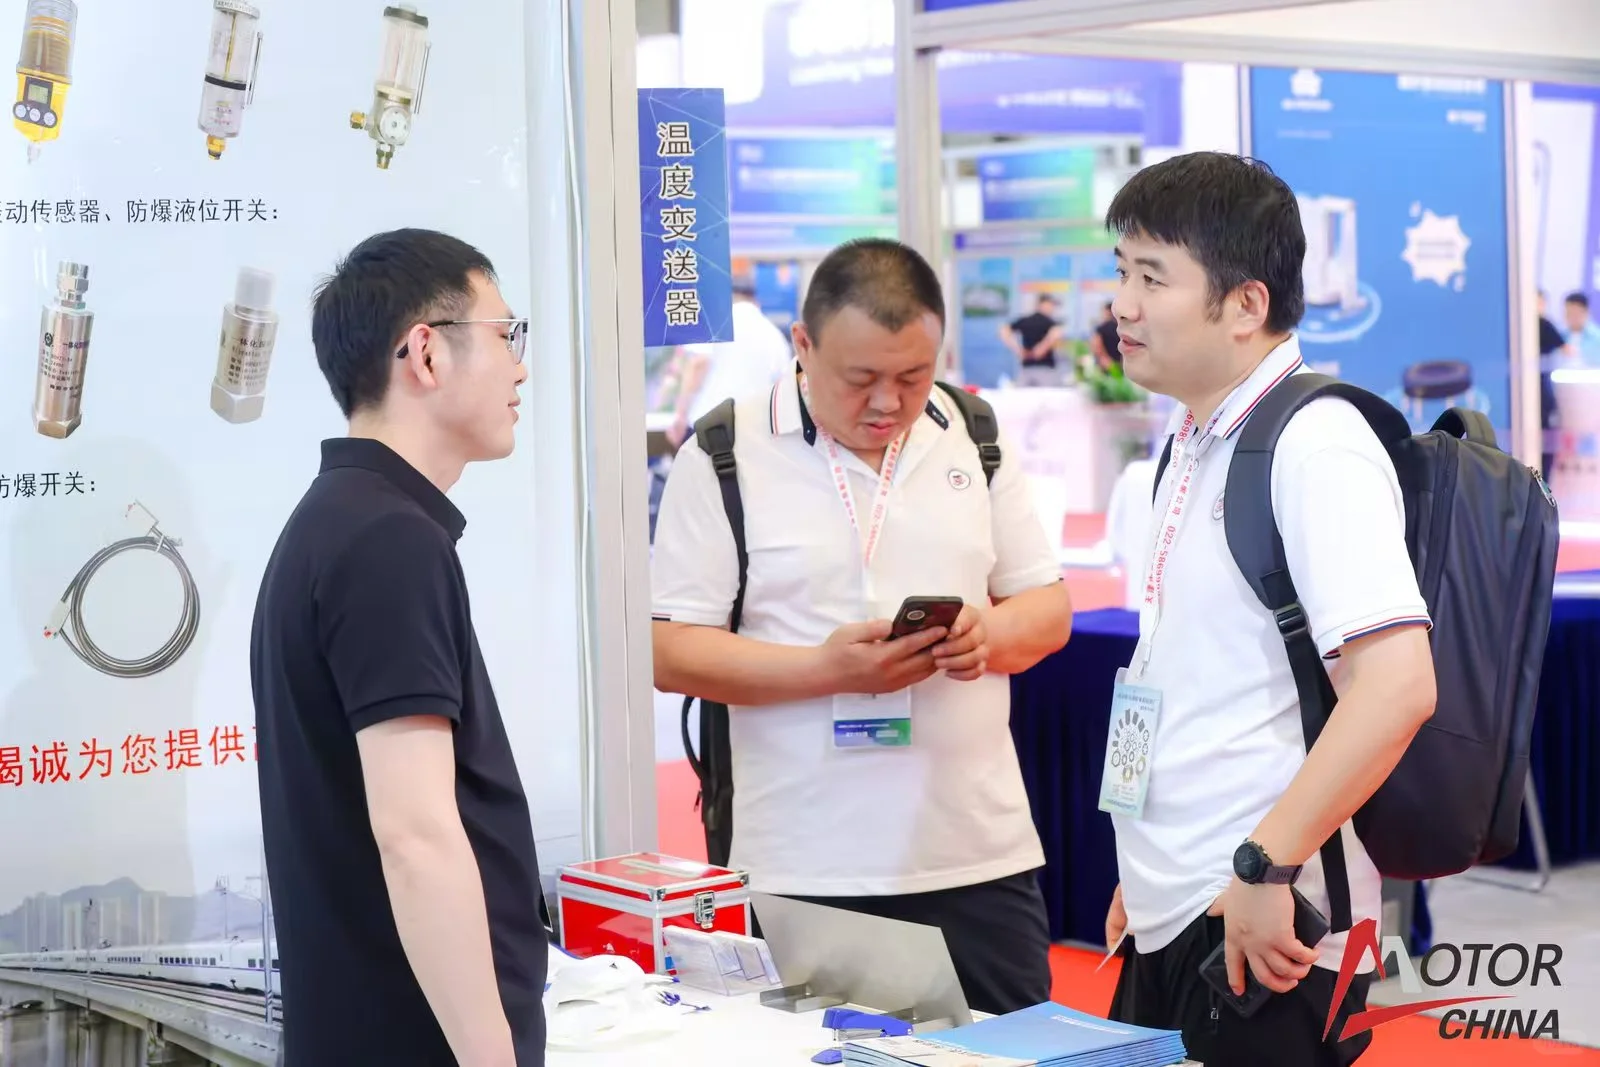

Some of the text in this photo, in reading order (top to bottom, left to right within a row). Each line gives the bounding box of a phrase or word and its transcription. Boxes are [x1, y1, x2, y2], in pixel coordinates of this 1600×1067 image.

[0, 198, 279, 224] 动传感器、防爆液位开关：
[656, 122, 700, 327] 温度变送器
[0, 724, 259, 787] 竭诚为您提供
